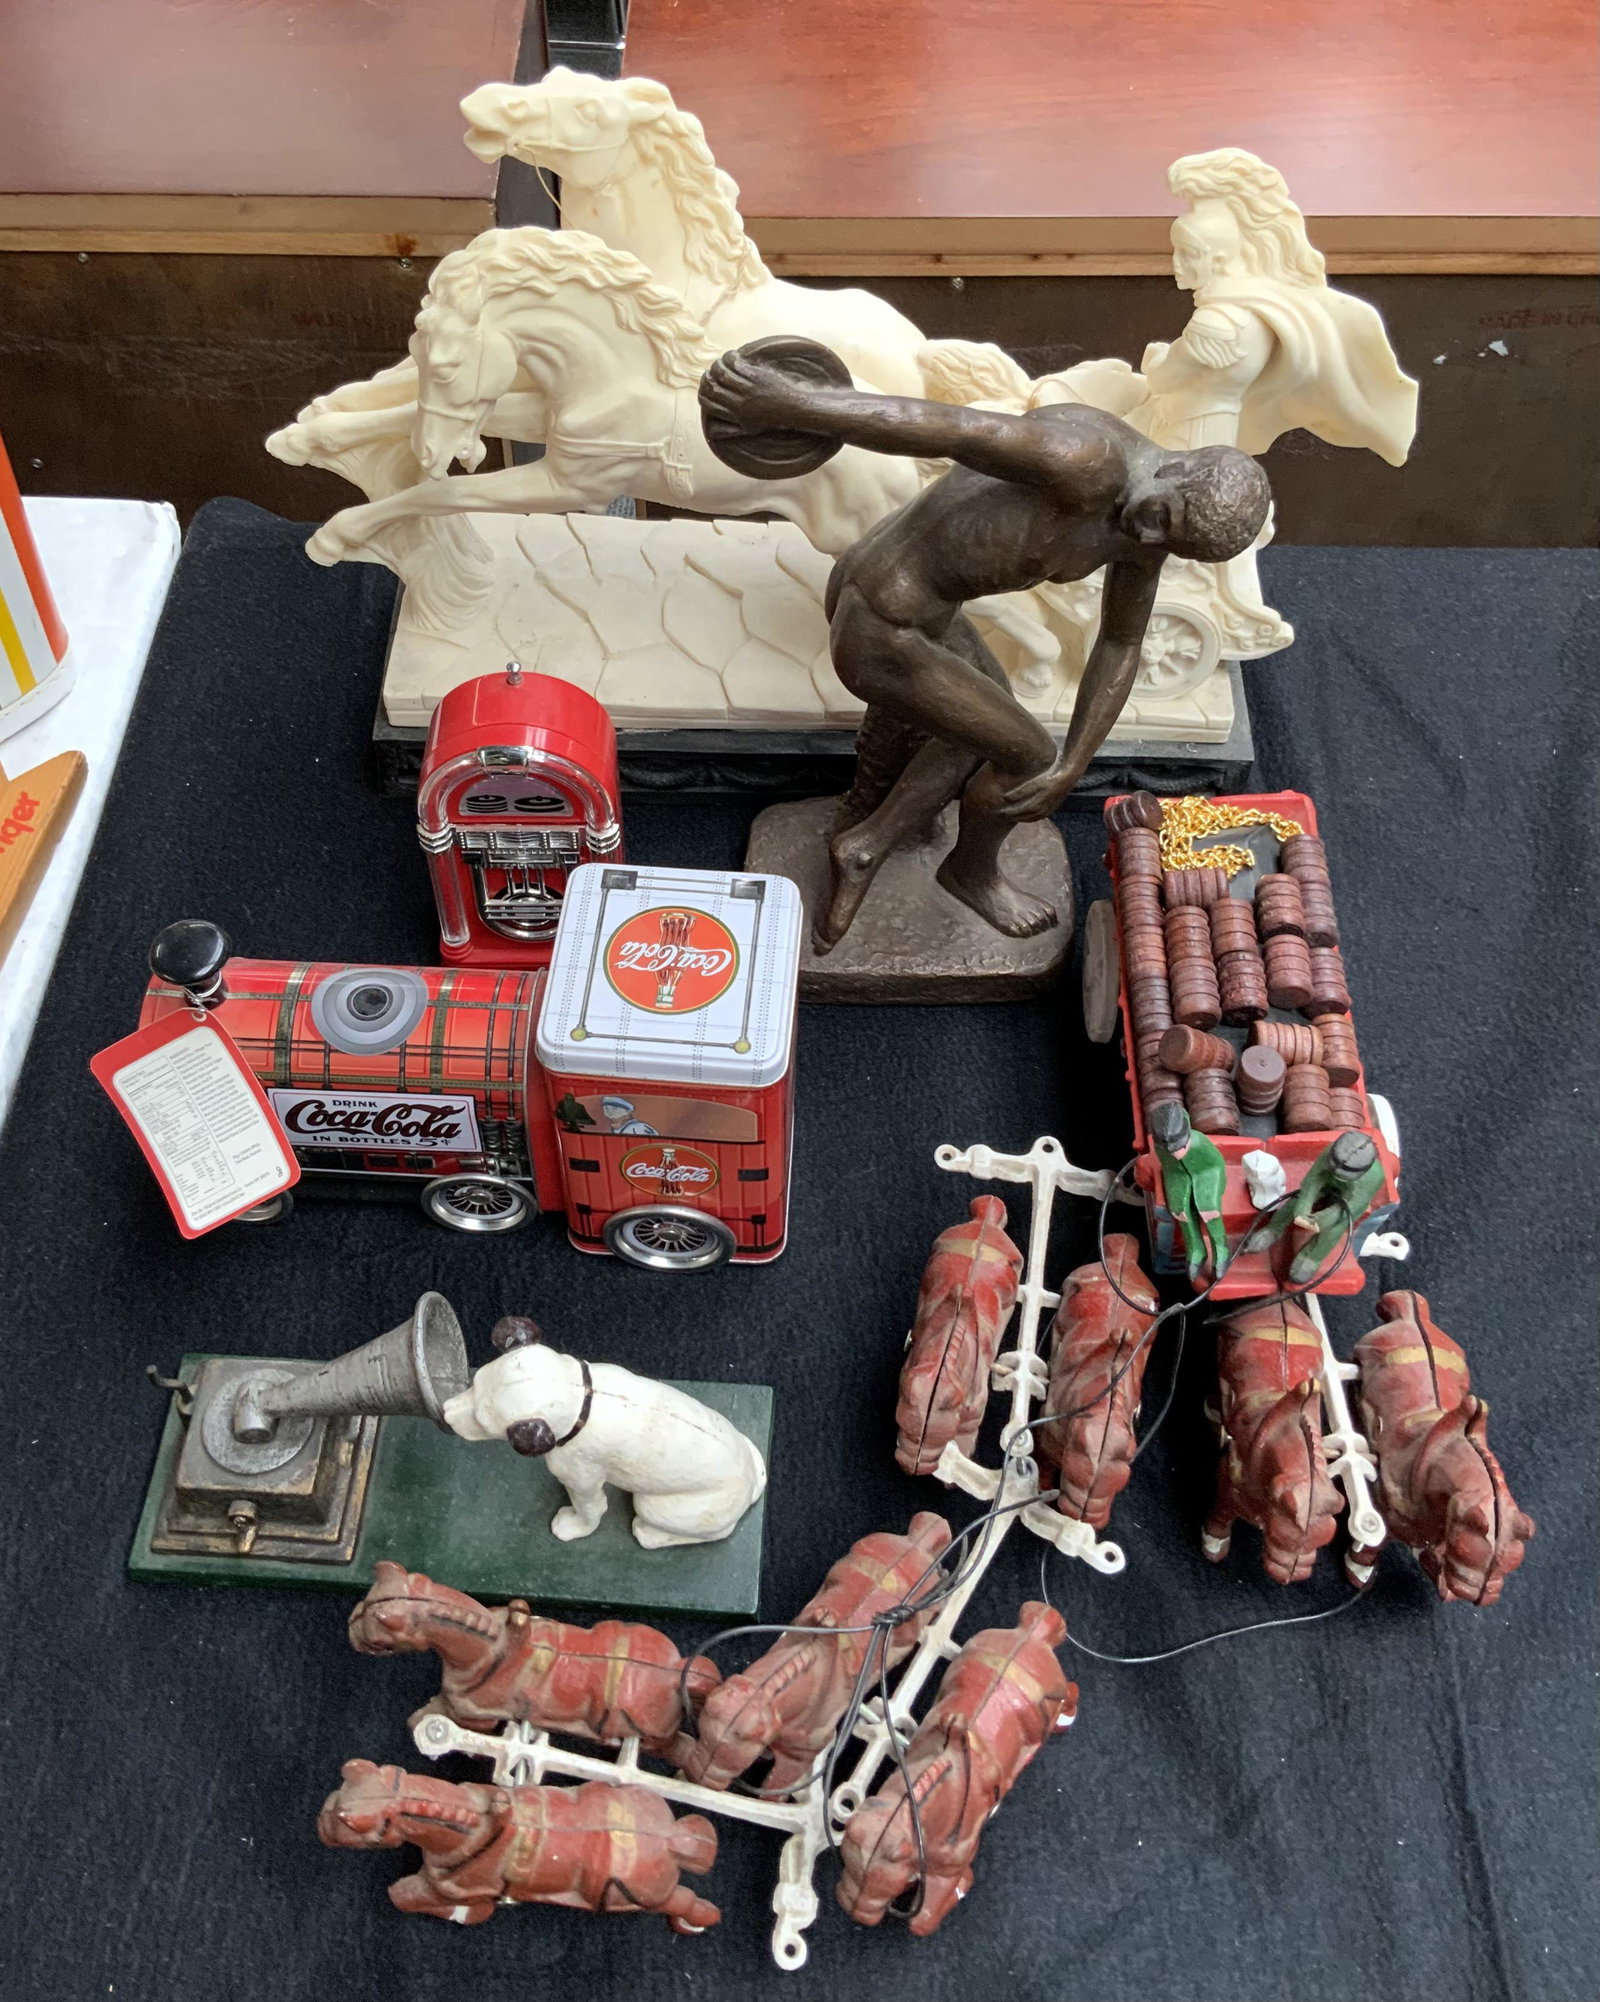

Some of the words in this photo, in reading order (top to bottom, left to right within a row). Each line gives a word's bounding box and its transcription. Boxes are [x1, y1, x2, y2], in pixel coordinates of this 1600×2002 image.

[332, 1099, 378, 1108] DRINK
[285, 1099, 466, 1139] Coca-Cola
[312, 1135, 331, 1143] IN
[338, 1136, 411, 1146] BOTTLES
